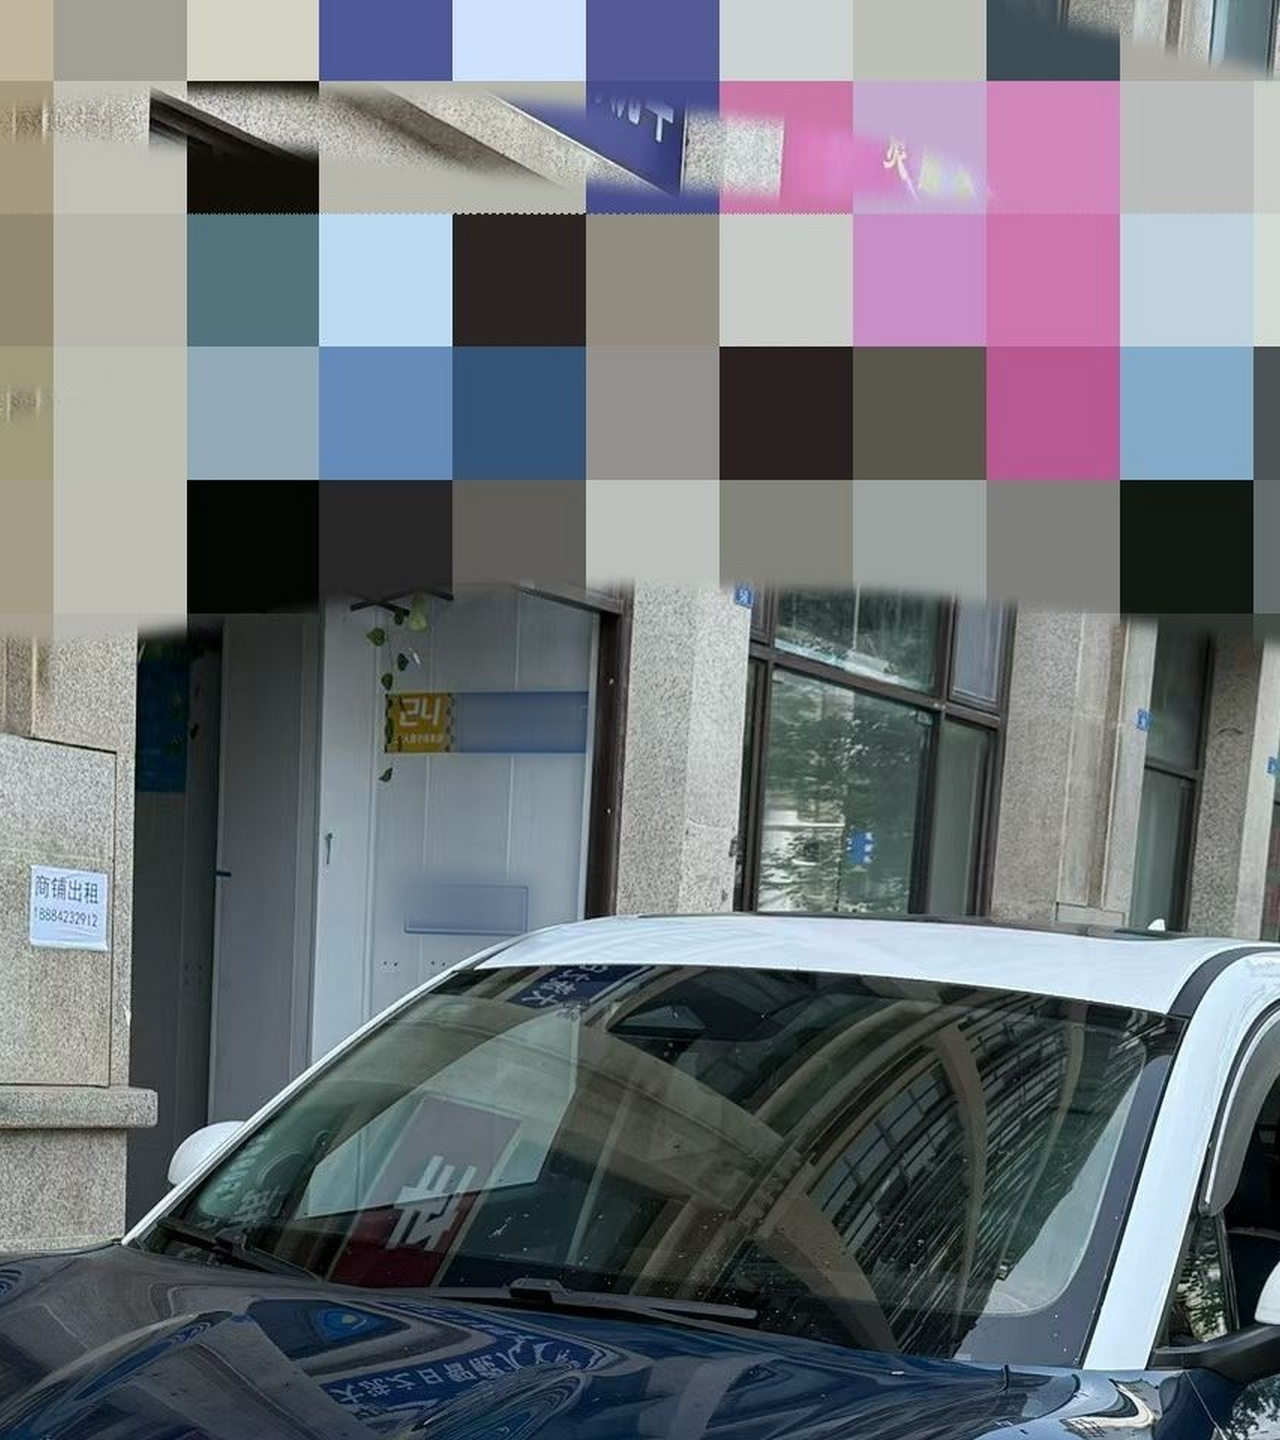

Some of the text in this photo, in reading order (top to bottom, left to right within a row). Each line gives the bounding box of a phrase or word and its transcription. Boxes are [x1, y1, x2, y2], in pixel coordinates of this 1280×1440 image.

[35, 876, 99, 904] 商铺出租
[34, 906, 98, 928] 18884232912
